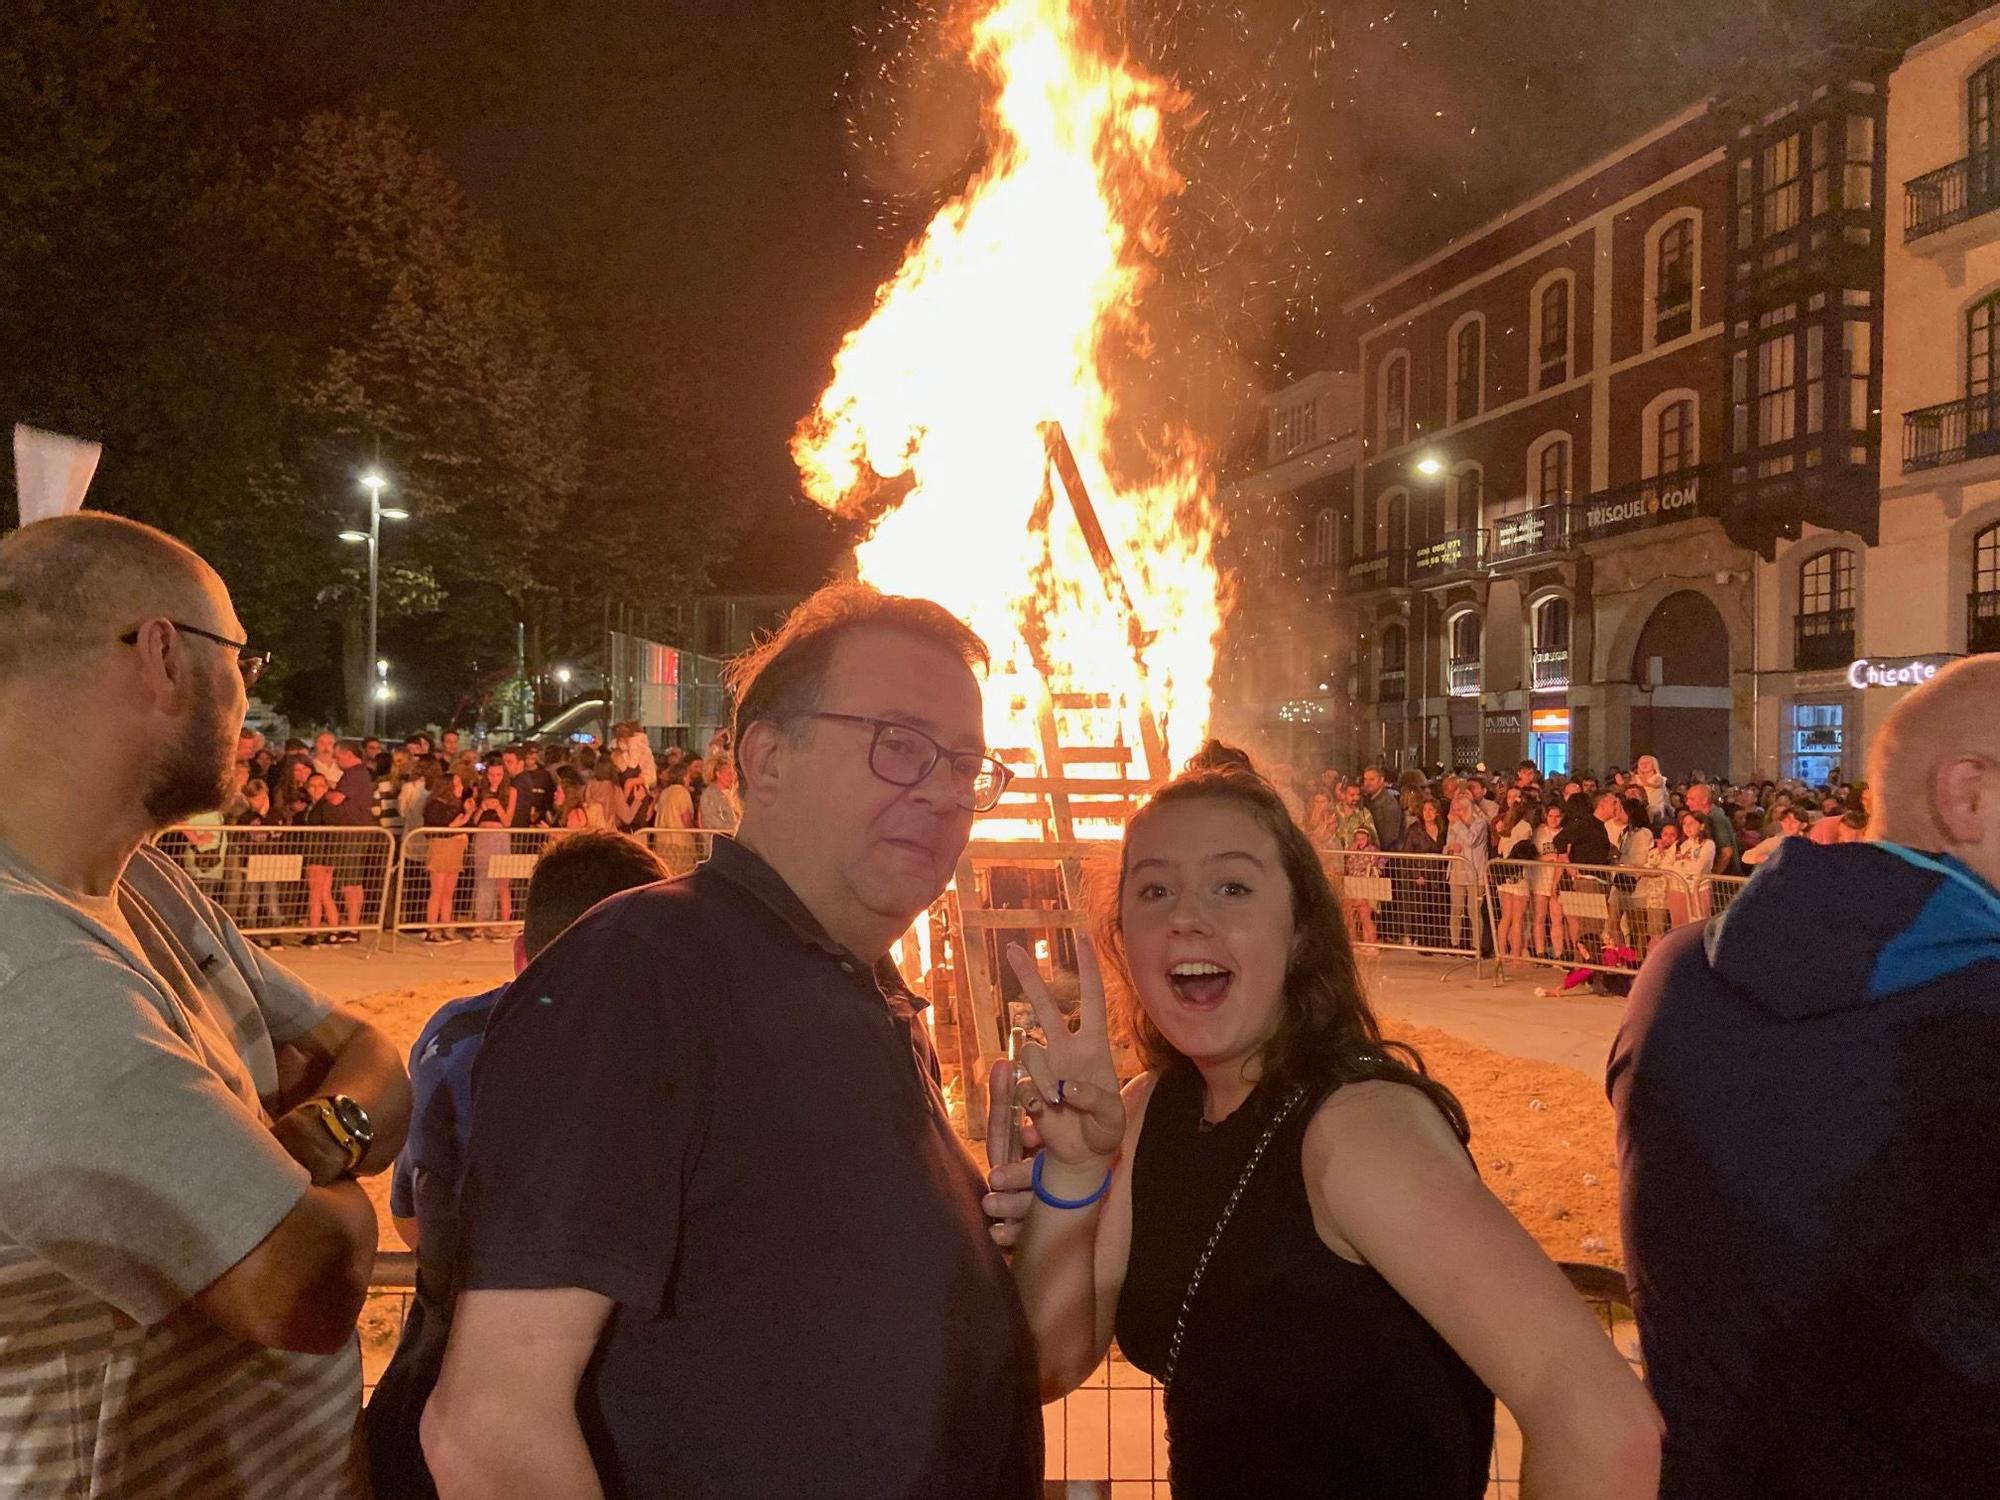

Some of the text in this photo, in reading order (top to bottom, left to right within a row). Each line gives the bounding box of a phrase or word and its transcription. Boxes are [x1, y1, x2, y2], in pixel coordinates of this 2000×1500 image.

[1586, 488, 1697, 527] TRISQUEL COM
[1848, 659, 1936, 689] Chicote
